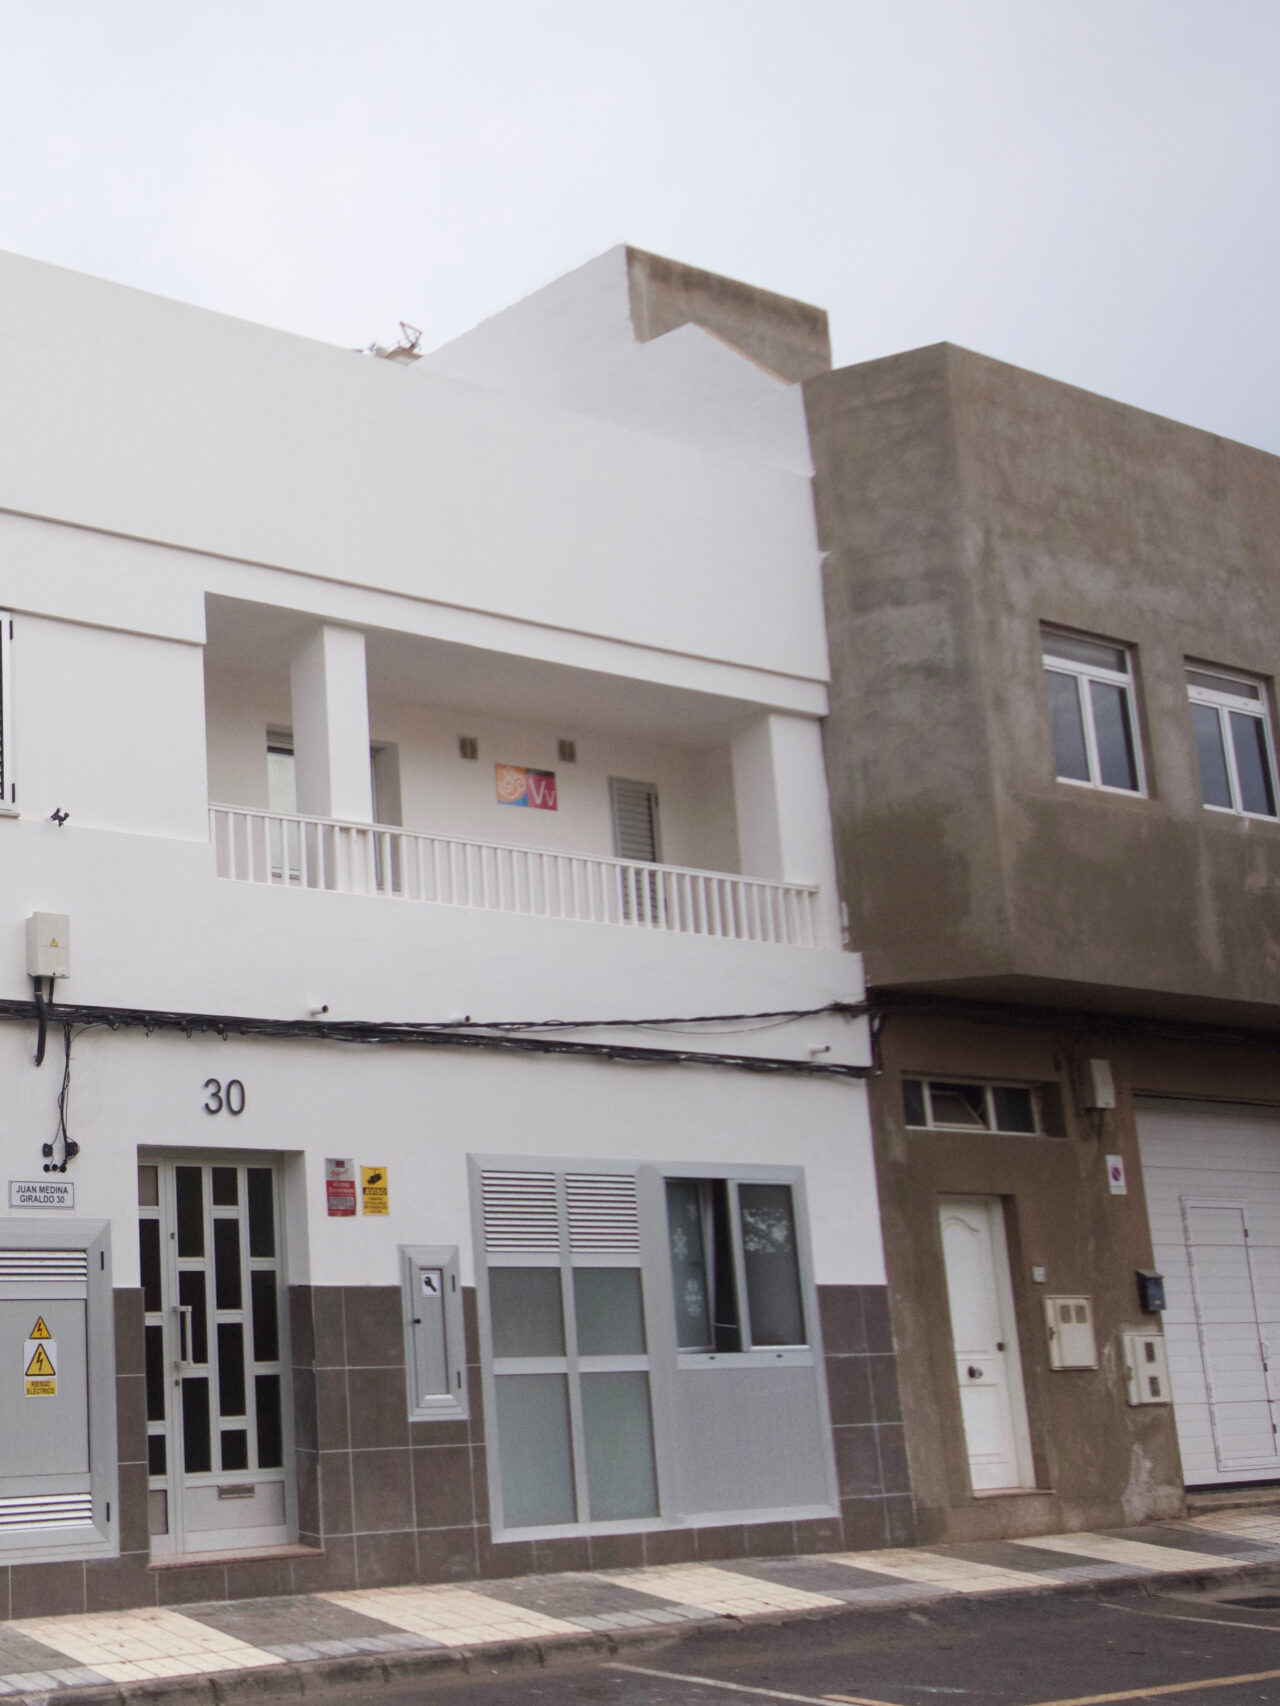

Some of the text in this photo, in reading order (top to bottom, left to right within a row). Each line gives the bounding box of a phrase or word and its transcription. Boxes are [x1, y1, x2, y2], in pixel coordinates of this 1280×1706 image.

[204, 1078, 246, 1115] 30
[16, 1185, 69, 1194] JUAN MEDINA
[20, 1194, 65, 1204] GIRALDO 30
[31, 1380, 51, 1388] RIESGO
